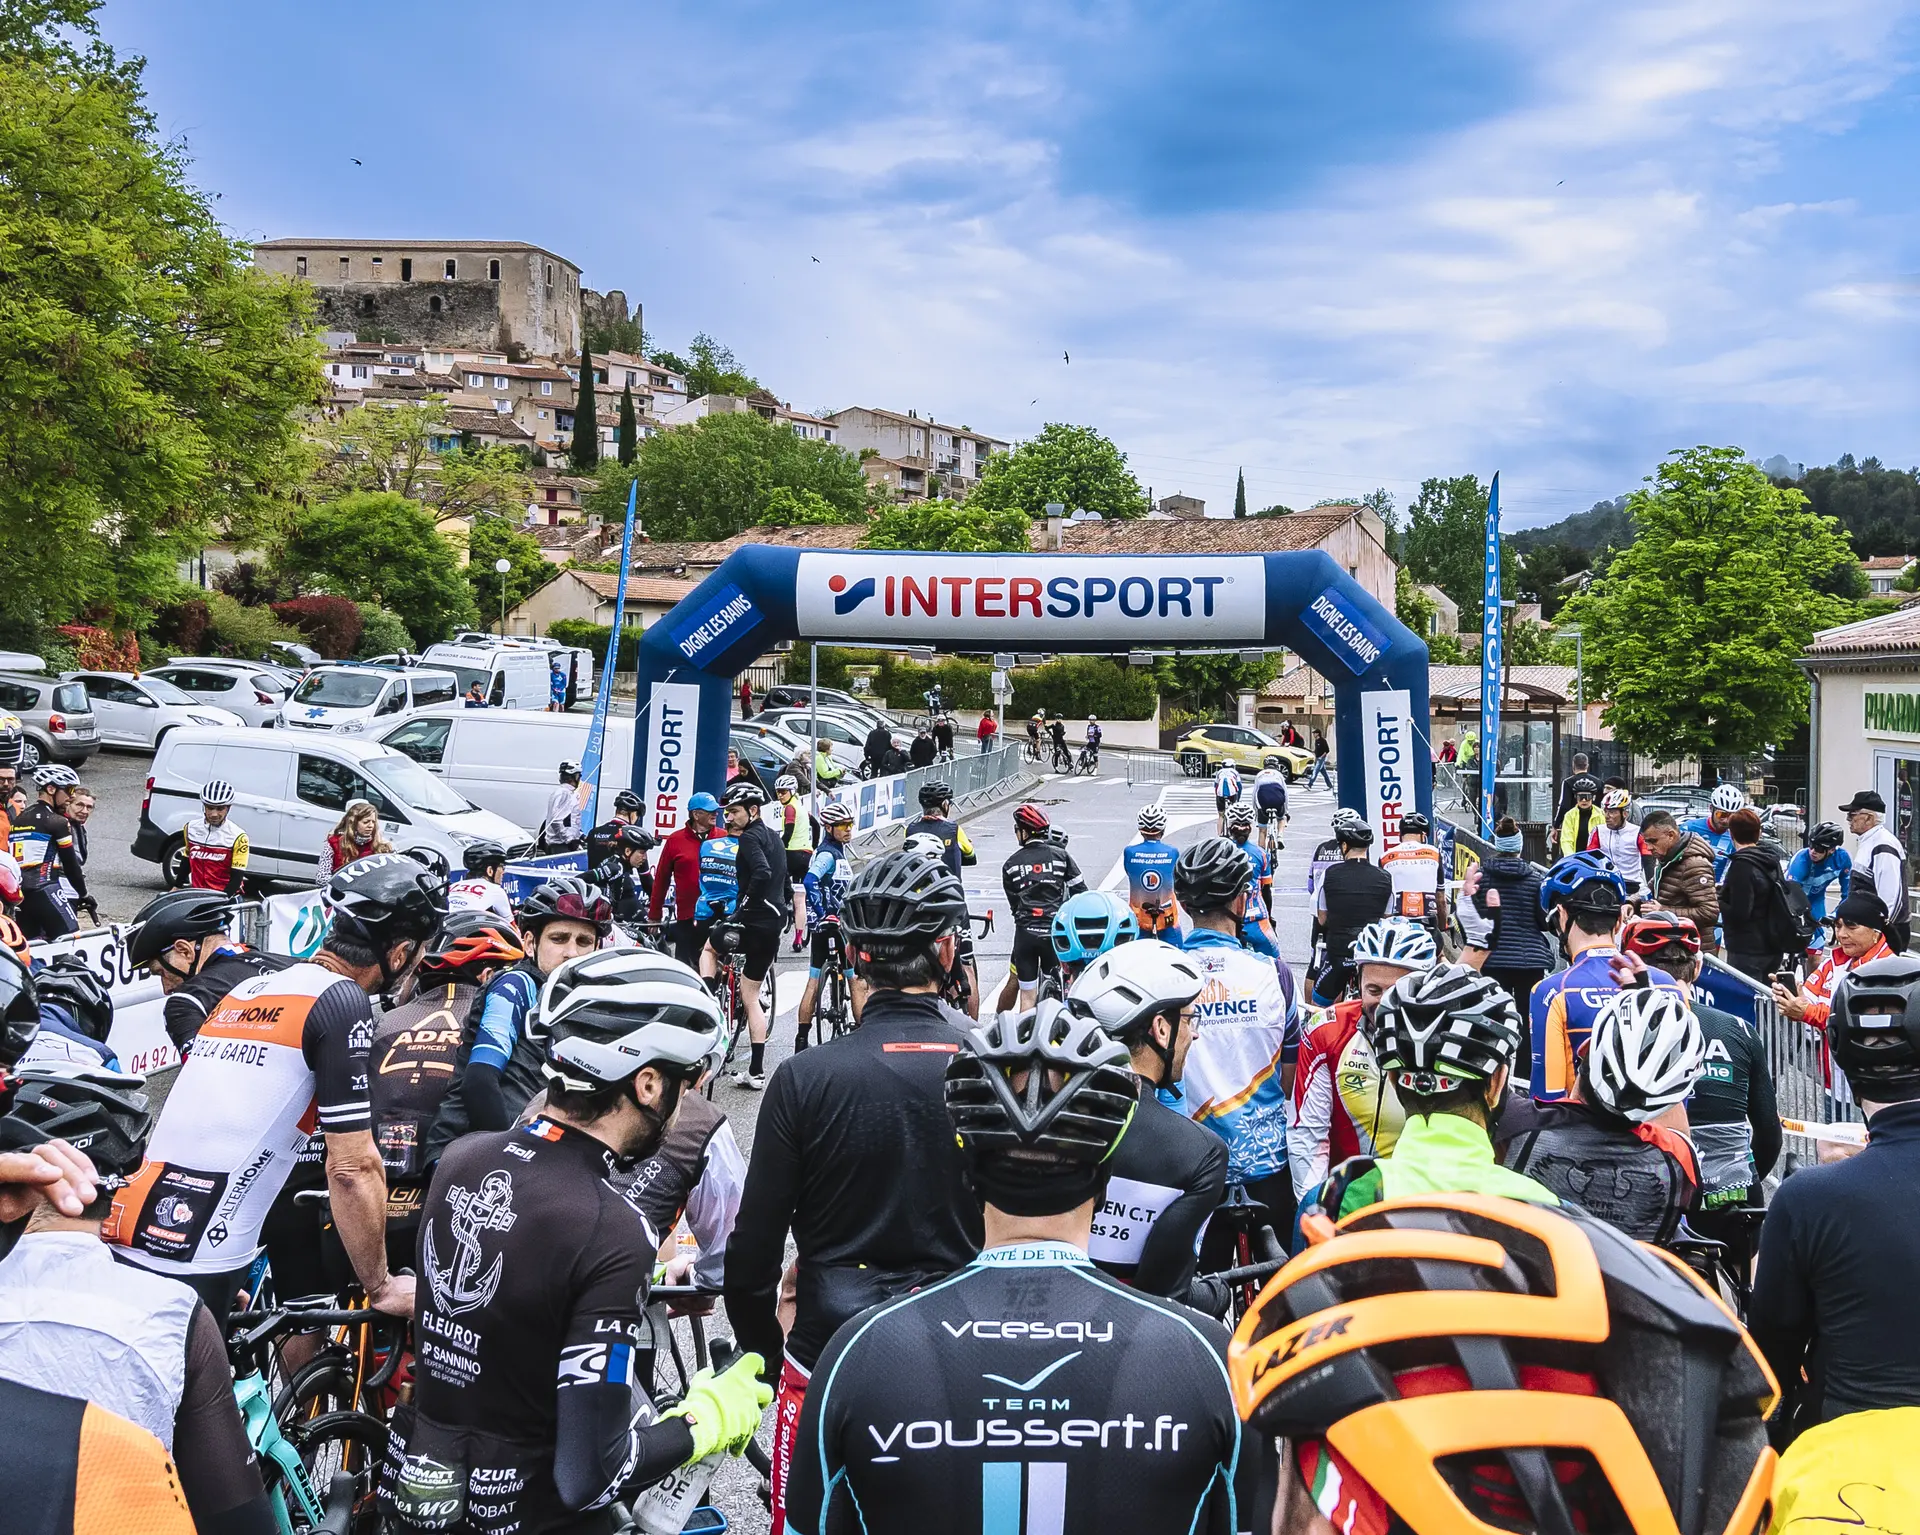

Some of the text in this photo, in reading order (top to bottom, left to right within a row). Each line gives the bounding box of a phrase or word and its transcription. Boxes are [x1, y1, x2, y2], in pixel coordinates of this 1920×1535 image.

[885, 575, 1225, 619] INTERSPORT
[679, 594, 752, 658] DIGNE LES BAINS
[1310, 595, 1381, 664] DIGNE LES BAINS
[1864, 692, 1920, 733] PHARM
[655, 704, 684, 840] TERSPORT
[1377, 712, 1404, 853] TERSPORT
[1024, 862, 1053, 875] POLI
[216, 1007, 285, 1023] ALTERHOME
[394, 1030, 462, 1046] ADR
[406, 1044, 447, 1052] SERVICES
[131, 1045, 168, 1074] 04 92
[220, 1042, 269, 1067] GARDE
[503, 1143, 536, 1161] poli
[219, 1148, 274, 1221] ALTERHOME
[625, 1160, 662, 1201] RDE 83
[1109, 1225, 1130, 1241] 26
[1022, 1249, 1045, 1261] DE
[422, 1310, 482, 1349] FLEUROT
[594, 1319, 622, 1333] LA
[433, 1346, 481, 1375] SANNINO
[782, 1400, 797, 1423] 26
[982, 1398, 1070, 1411] TEAM
[389, 1430, 407, 1450] ZUR
[868, 1413, 1188, 1452] voussert.fr
[382, 1462, 399, 1479] BAT
[471, 1467, 517, 1481] AZUR
[293, 1463, 325, 1524] Bianc
[468, 1500, 517, 1518] MOBAT
